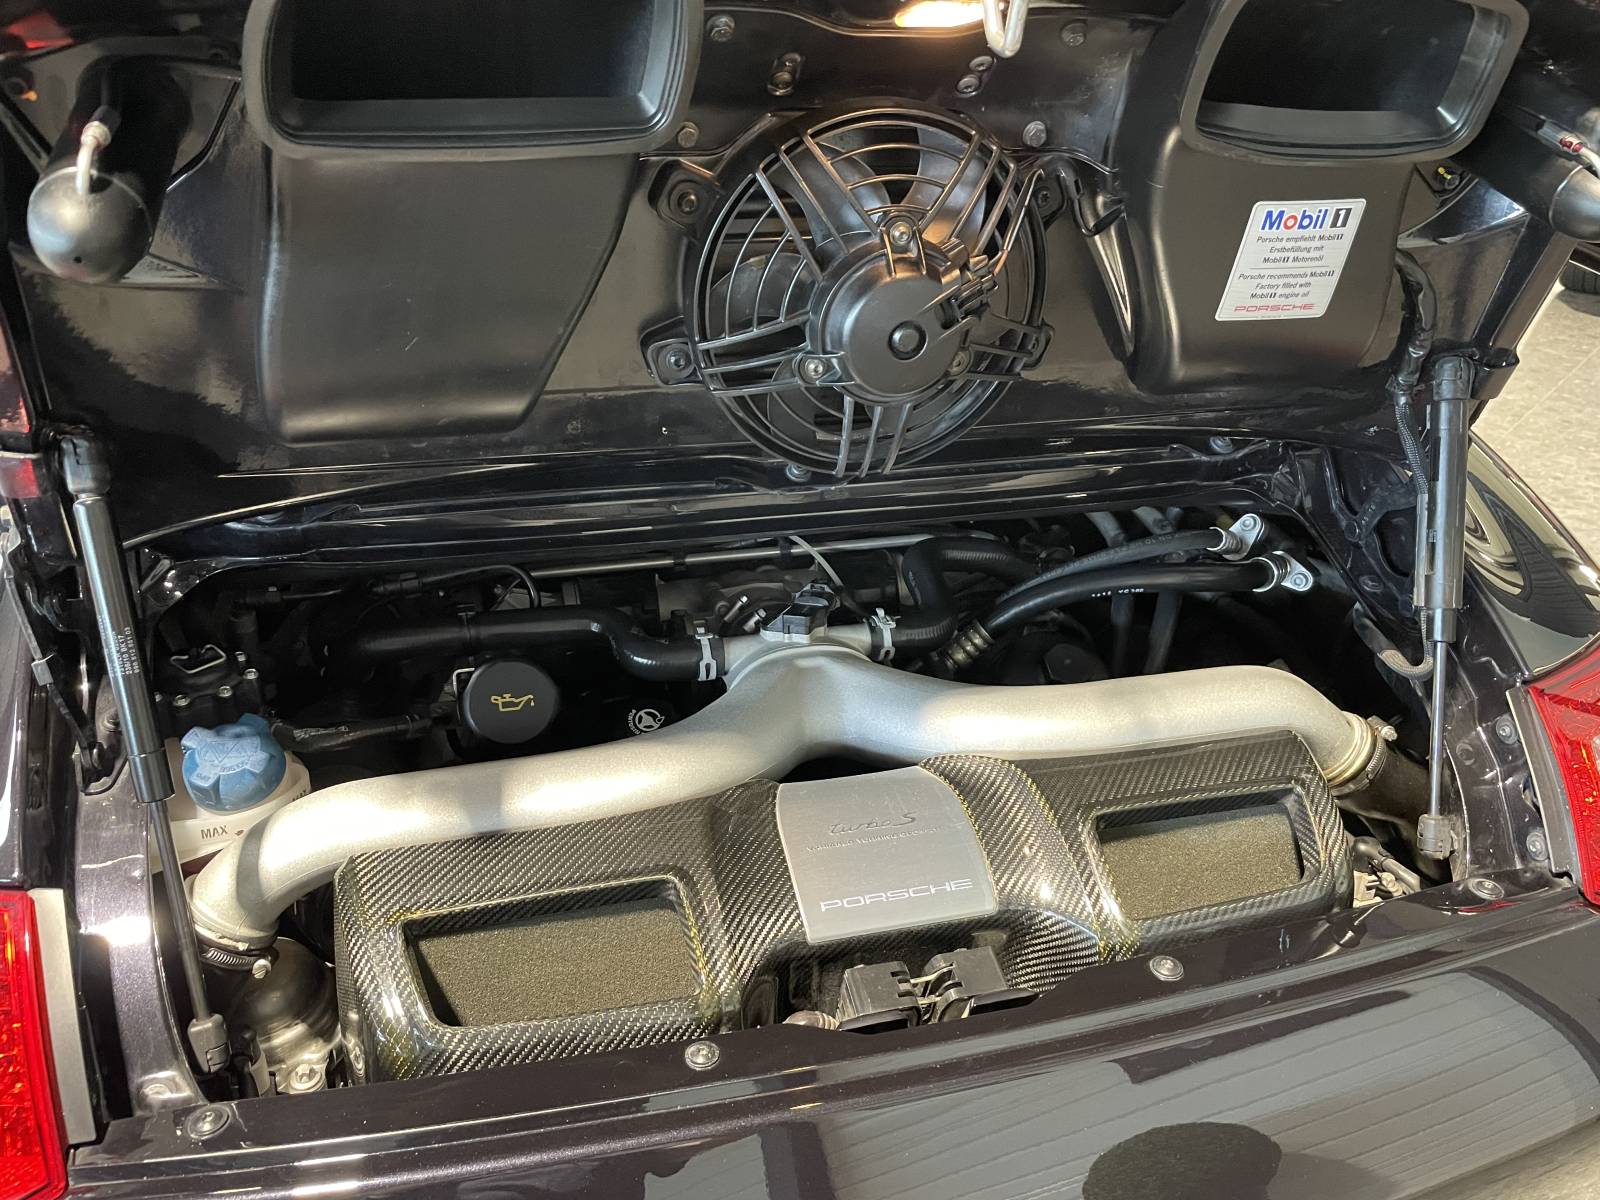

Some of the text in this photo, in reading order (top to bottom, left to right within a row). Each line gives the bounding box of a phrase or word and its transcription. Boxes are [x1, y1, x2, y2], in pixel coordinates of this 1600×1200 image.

[1260, 208, 1329, 231] Mobil
[1256, 235, 1285, 244] Porsche
[1285, 235, 1317, 245] empfiehlt
[1269, 245, 1312, 255] Erstbefüllung
[1292, 255, 1324, 263] Motorenöl
[1238, 273, 1266, 281] Porsche
[1266, 272, 1308, 281] recommends
[1254, 282, 1281, 291] Factory
[1281, 281, 1298, 289] filled
[1278, 292, 1300, 300] engine
[1233, 303, 1315, 313] PORSCHE
[200, 824, 229, 839] MAX
[819, 878, 974, 912] PORSCHE
